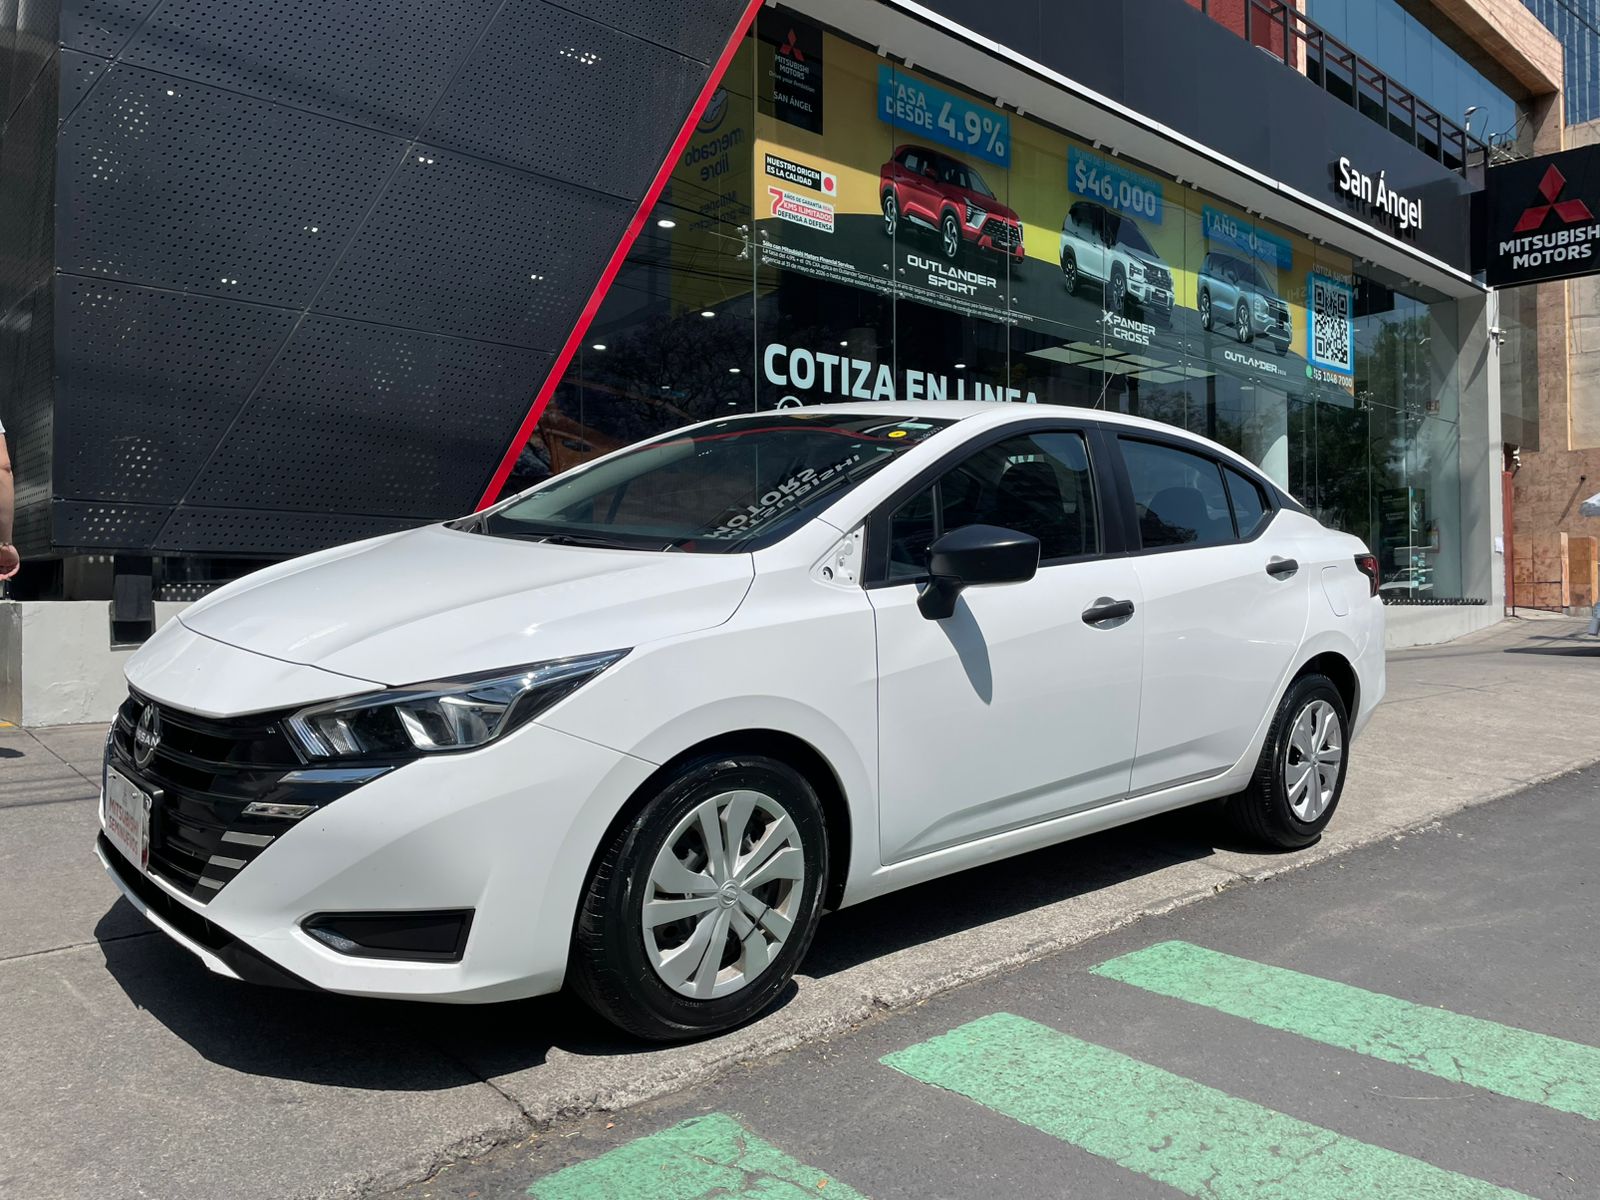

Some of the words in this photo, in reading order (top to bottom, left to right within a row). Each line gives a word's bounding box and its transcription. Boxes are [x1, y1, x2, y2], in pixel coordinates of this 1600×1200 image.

[775, 54, 810, 74] MITSUBISHI
[780, 64, 805, 80] MOTORS
[773, 91, 788, 103] SAN
[790, 95, 813, 113] ÁNGEL
[886, 96, 933, 129] DESDE
[937, 101, 1005, 157] 4.9%
[766, 156, 796, 172] NUESTRO
[796, 164, 820, 180] ORIGEN
[766, 165, 775, 174] ES
[775, 168, 784, 178] LA
[785, 170, 812, 186] CALIDAD
[1075, 159, 1156, 217] $46,000
[1340, 156, 1372, 203] San
[1375, 170, 1422, 229] Ángel
[769, 187, 783, 215] 7
[783, 202, 797, 211] KMS
[798, 206, 832, 222] ILIMITADOS
[778, 209, 803, 222] DEFENSA
[808, 219, 833, 231] DEFENSA
[1499, 224, 1600, 256] MITSUBISH
[1512, 243, 1592, 269] MOTORS
[907, 254, 997, 288] OUTLANDER
[928, 274, 977, 296] SPORT
[1102, 309, 1156, 336] XPANDER
[1113, 327, 1149, 346] CROSS
[763, 343, 897, 401] COTIZA
[906, 368, 947, 401] EN
[1224, 350, 1277, 374] OUTLANDER
